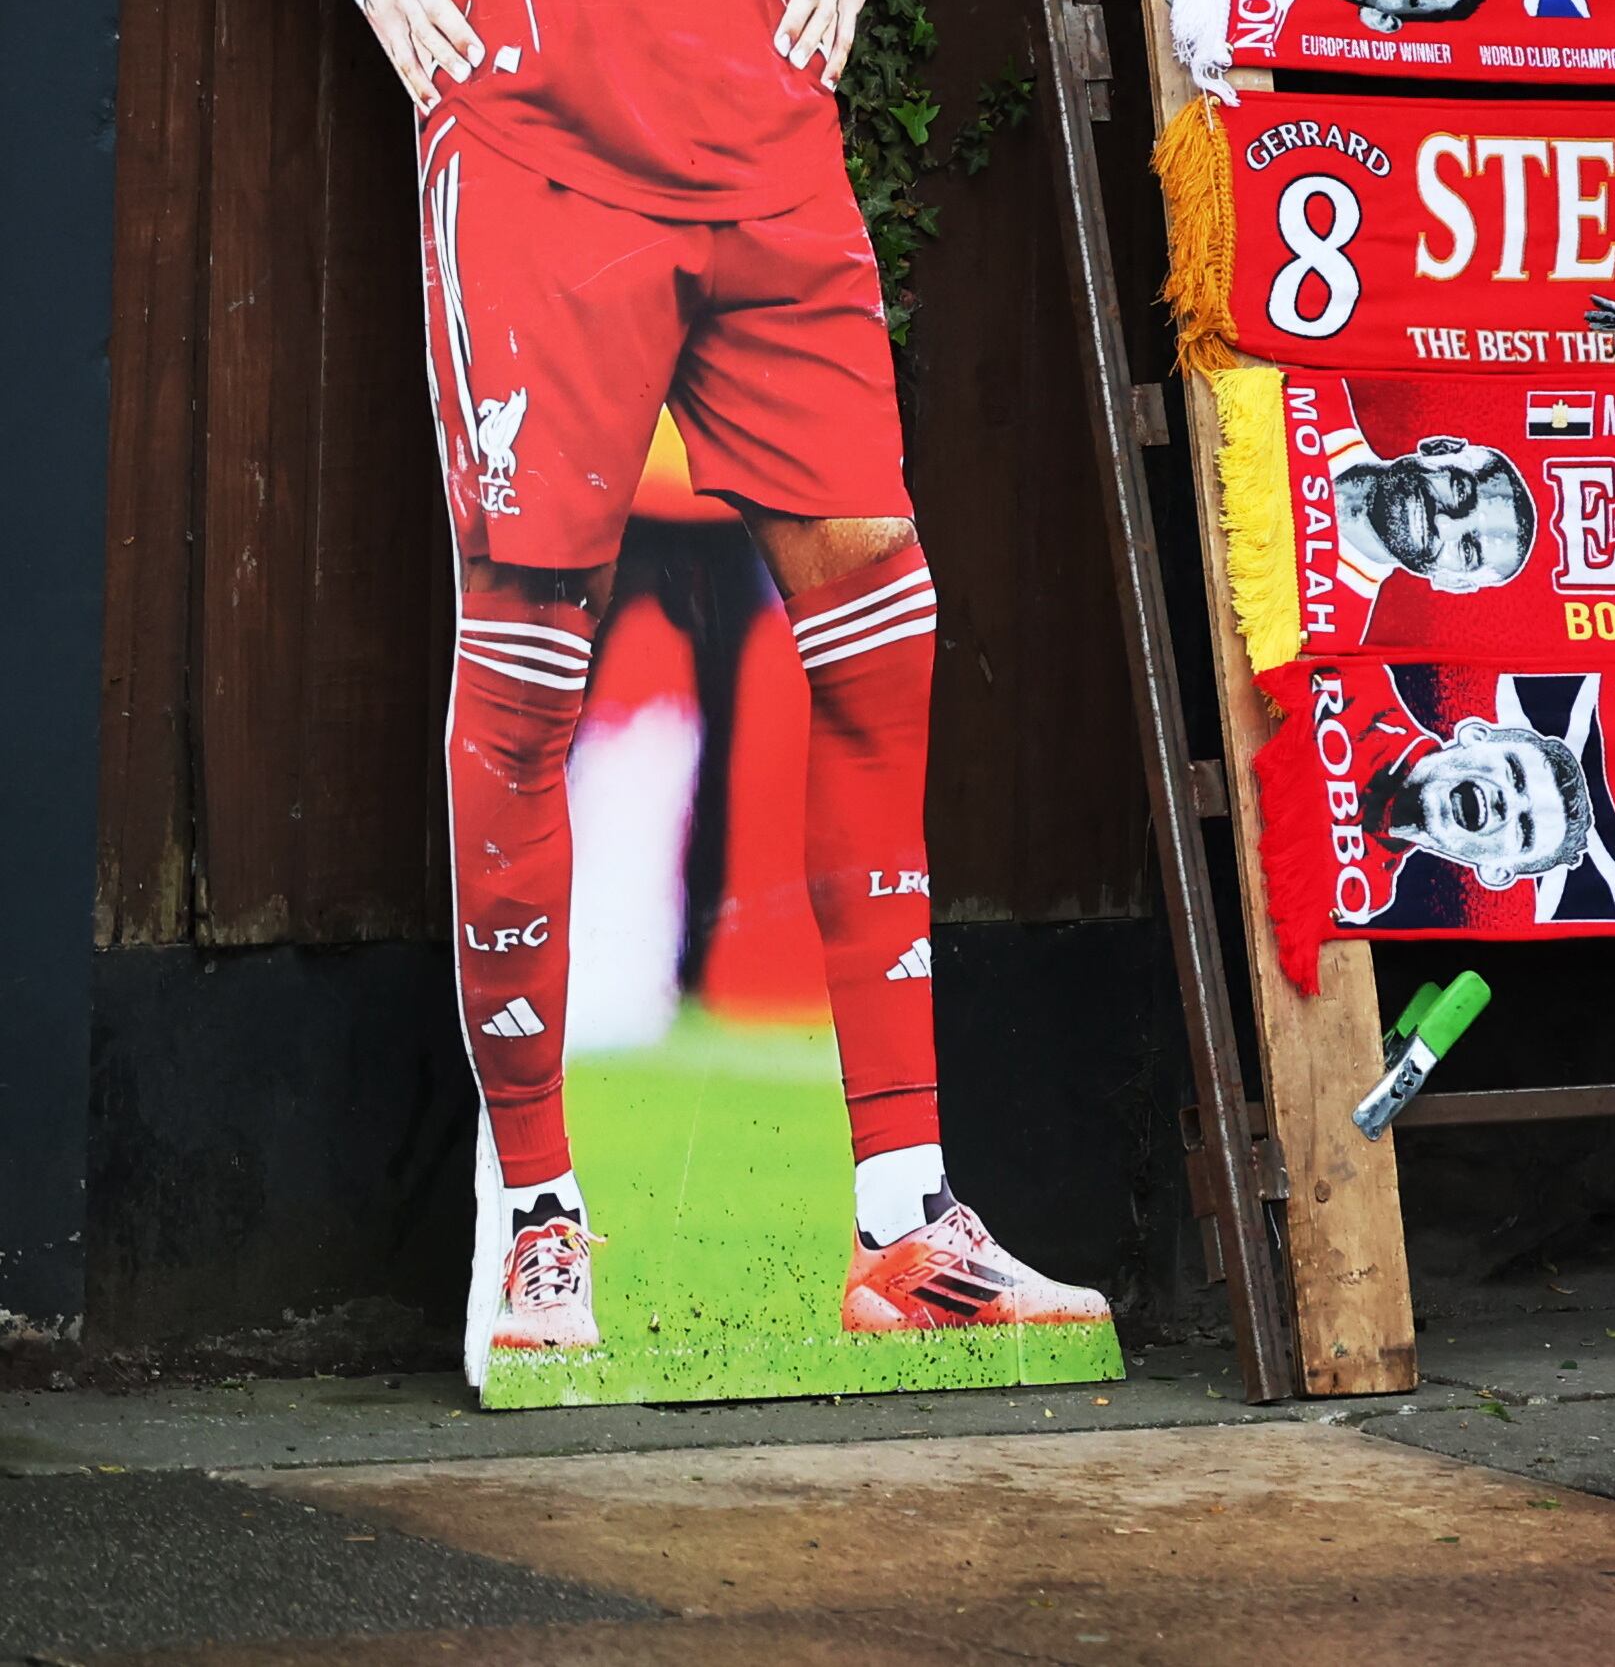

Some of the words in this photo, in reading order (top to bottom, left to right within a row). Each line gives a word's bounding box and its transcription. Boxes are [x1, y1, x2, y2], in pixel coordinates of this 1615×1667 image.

[1301, 34, 1370, 59] EUROPEAN
[1372, 40, 1397, 61] CUP
[1399, 41, 1452, 64] WINNER
[1479, 45, 1524, 67] WORLD
[1528, 46, 1561, 68] CLUB
[1245, 120, 1391, 178] GERRARD
[1267, 174, 1361, 338] 8
[1406, 326, 1471, 361] THE
[1477, 329, 1550, 363] BEST
[1286, 386, 1321, 456] MO
[1301, 475, 1336, 634] SALAH
[1313, 675, 1371, 922] ROBBO
[464, 915, 549, 952] LFC
